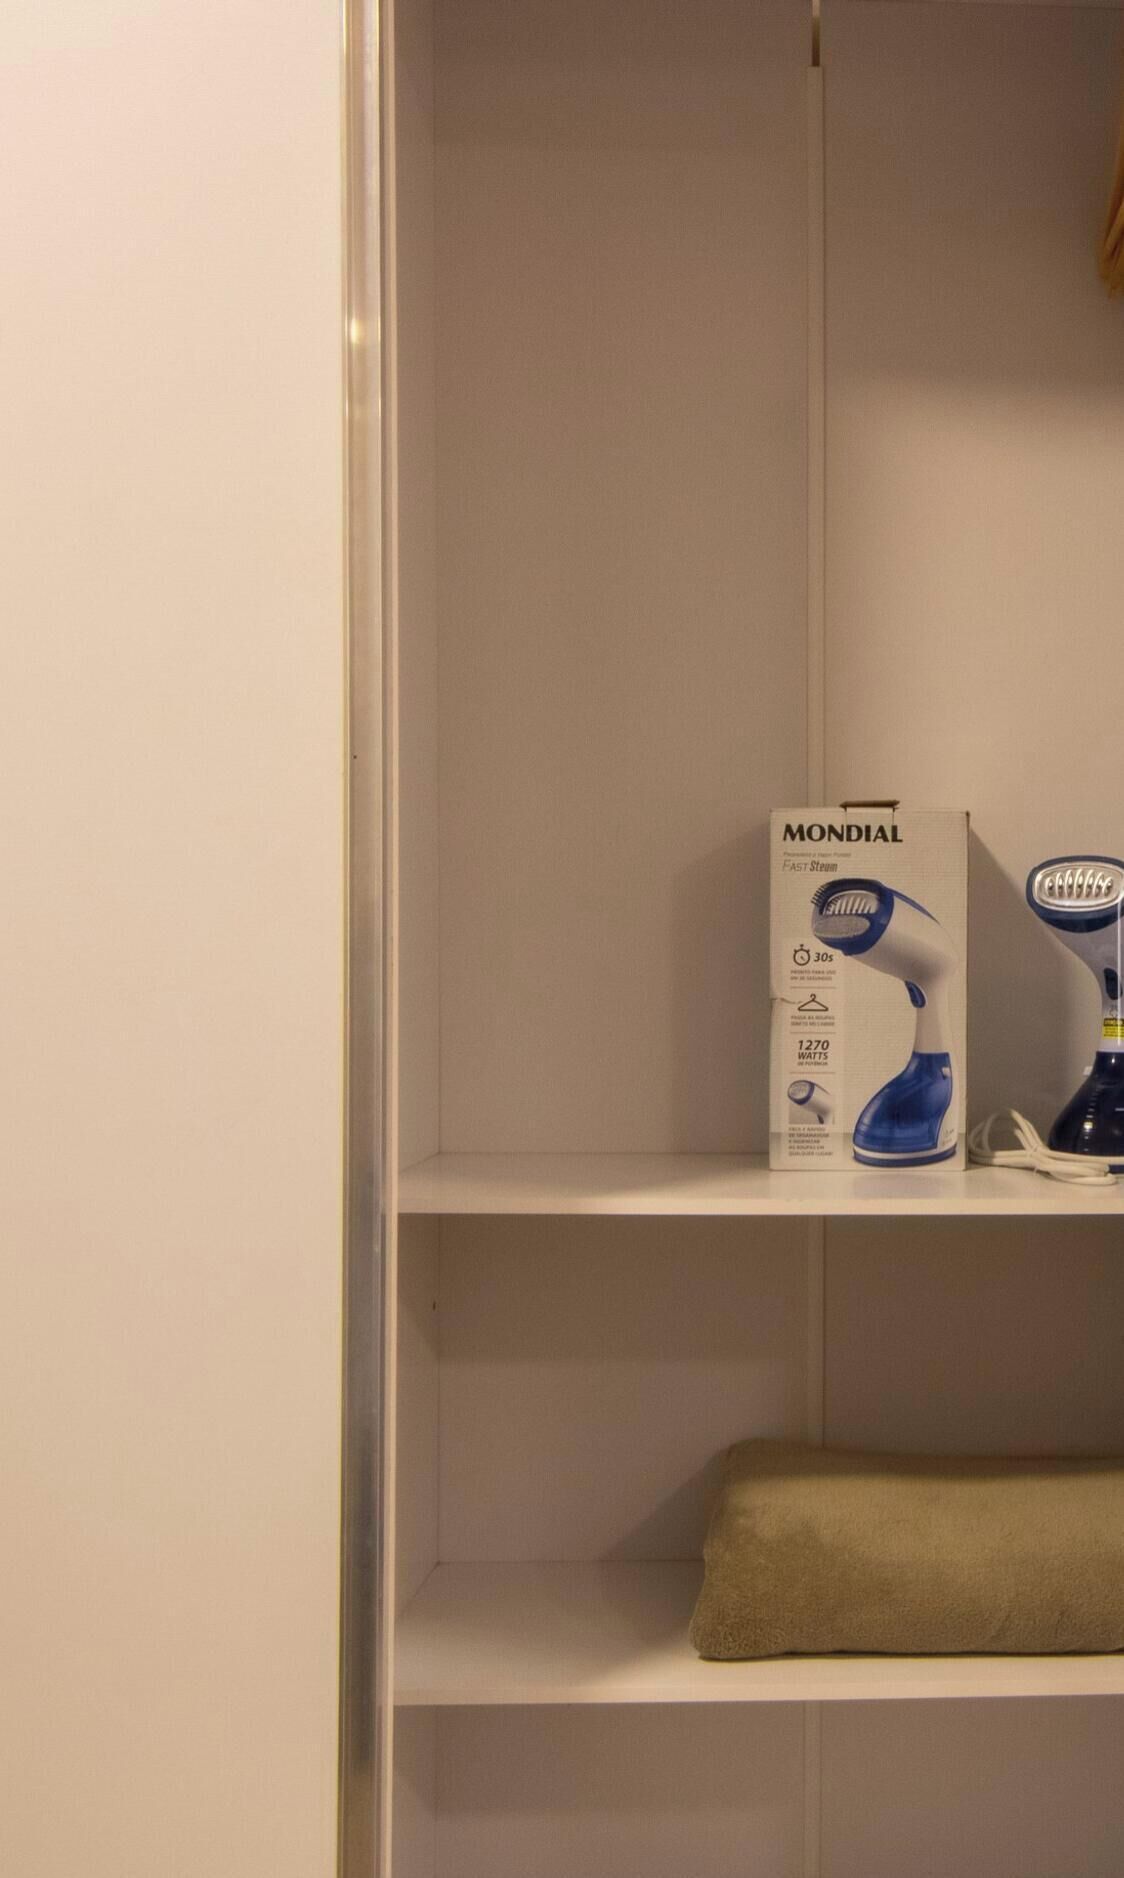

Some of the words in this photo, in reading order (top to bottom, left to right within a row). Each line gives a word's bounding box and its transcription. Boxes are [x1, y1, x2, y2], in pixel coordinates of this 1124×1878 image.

[783, 824, 903, 842] MONDIAL
[813, 952, 834, 962] 30s
[798, 1040, 830, 1051] 1270
[798, 1052, 828, 1060] WATTS
